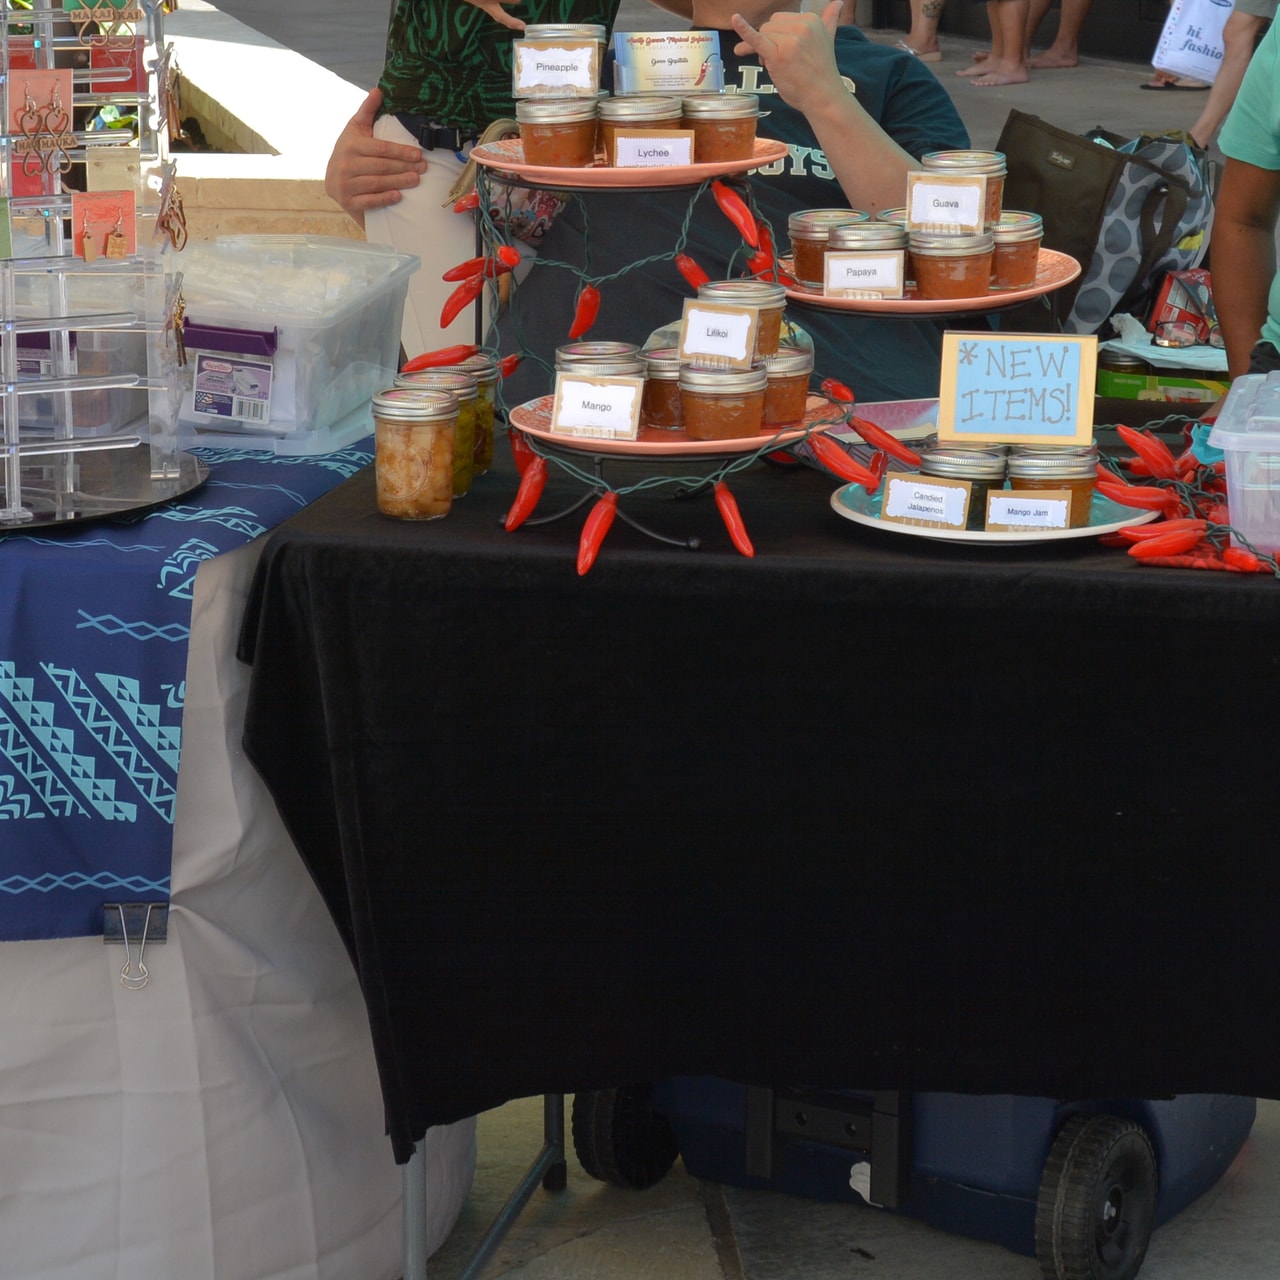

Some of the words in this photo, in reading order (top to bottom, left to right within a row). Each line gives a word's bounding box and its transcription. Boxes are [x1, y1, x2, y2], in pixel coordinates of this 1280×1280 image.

[1179, 39, 1224, 60] fashio
[536, 62, 578, 73] Pineapple
[41, 136, 77, 149] MAUKA
[638, 148, 669, 159] Lychee
[932, 198, 959, 208] Guava
[846, 267, 877, 278] Papaya
[706, 327, 728, 338] Lilikoi
[985, 344, 1069, 379] NEW
[581, 400, 612, 413] Mango
[962, 383, 1071, 424] ITEMS!
[913, 490, 943, 503] Candied
[907, 503, 944, 515] Jalapenos
[1007, 507, 1031, 517] Mango
[1033, 507, 1048, 516] Jam
